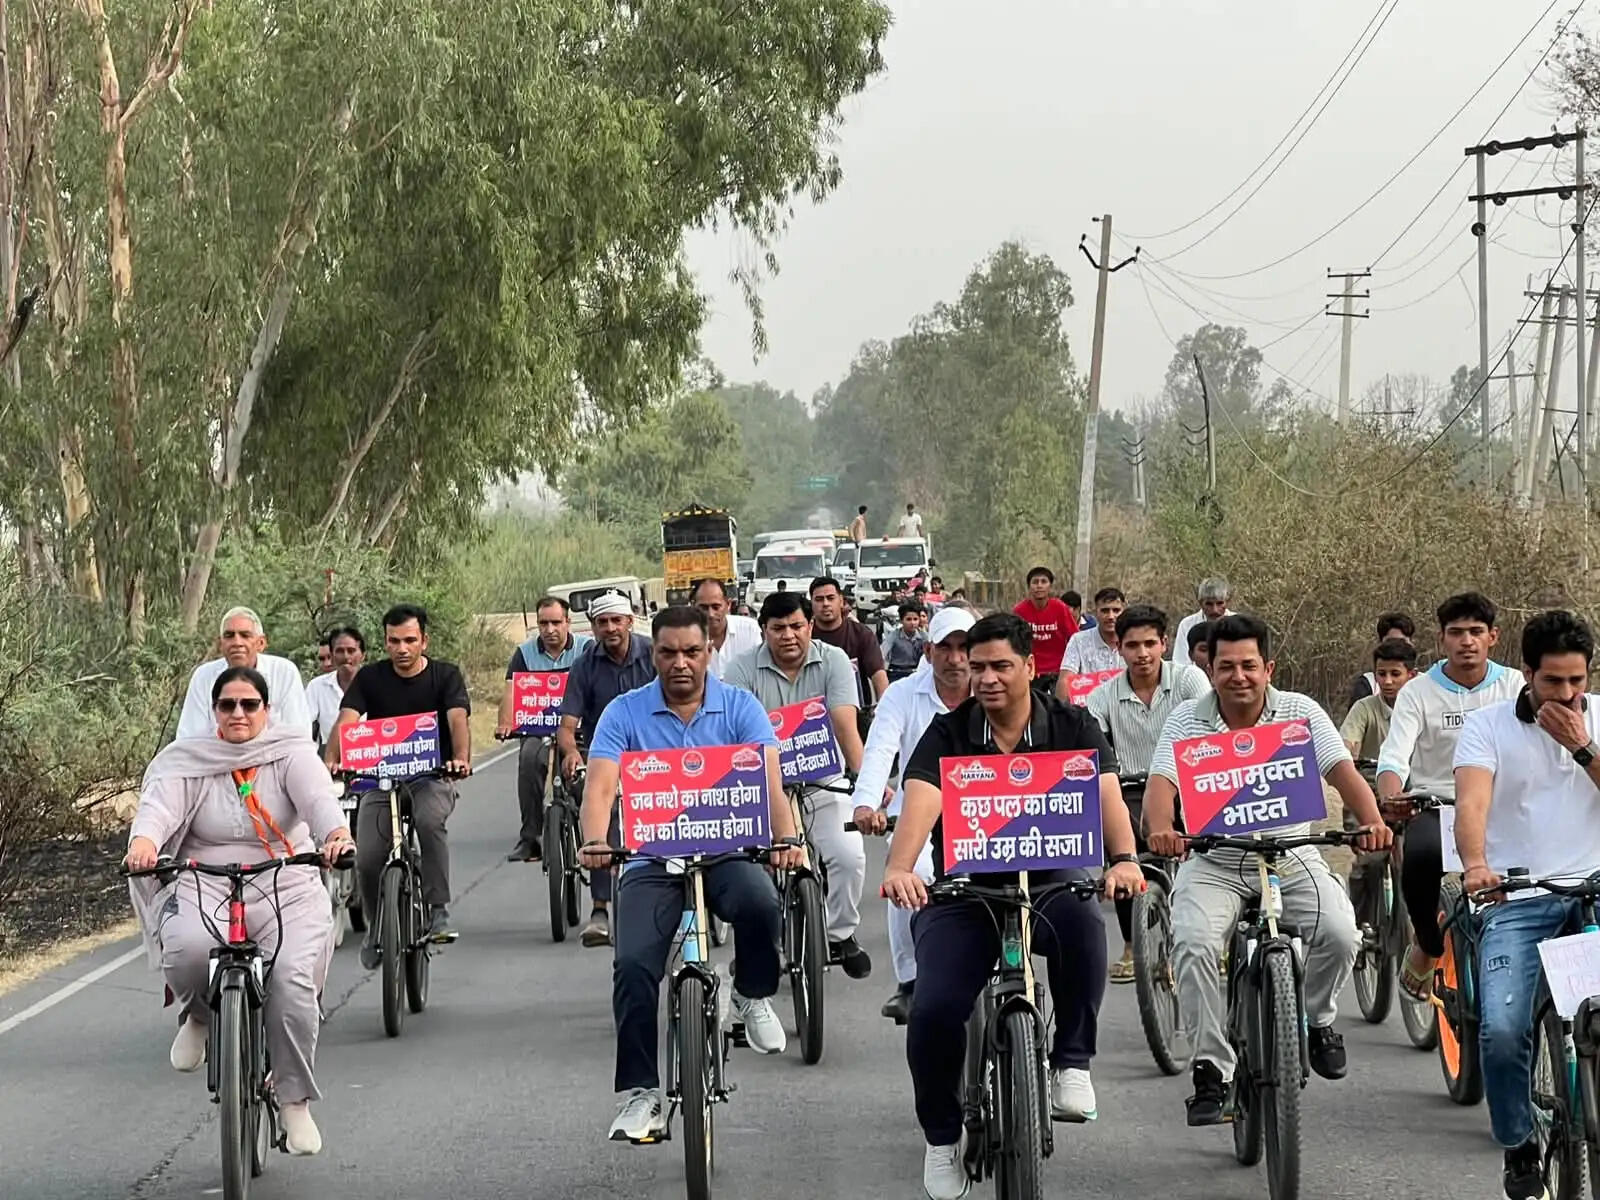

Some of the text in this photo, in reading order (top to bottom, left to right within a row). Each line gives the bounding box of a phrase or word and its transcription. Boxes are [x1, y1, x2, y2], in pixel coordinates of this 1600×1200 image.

[1445, 715, 1464, 726] TID
[345, 736, 435, 761] जब नशे का नाश होगा
[794, 724, 830, 751] अपनाओ
[1192, 748, 1222, 759] HARYANA
[638, 764, 670, 772] HARYANA
[960, 771, 996, 780] HARYANA
[629, 779, 761, 811] जब नशे का नाश होगा
[960, 791, 1084, 831] कुछ पल का नशा
[1223, 796, 1288, 826] भारत
[633, 818, 656, 842] देश
[657, 820, 676, 841] का
[677, 813, 721, 841] विकास
[722, 812, 753, 840] होगा
[952, 829, 990, 862] सारी
[989, 836, 1016, 863] उम्र
[1018, 826, 1043, 858] की
[1044, 833, 1083, 857] सजा
